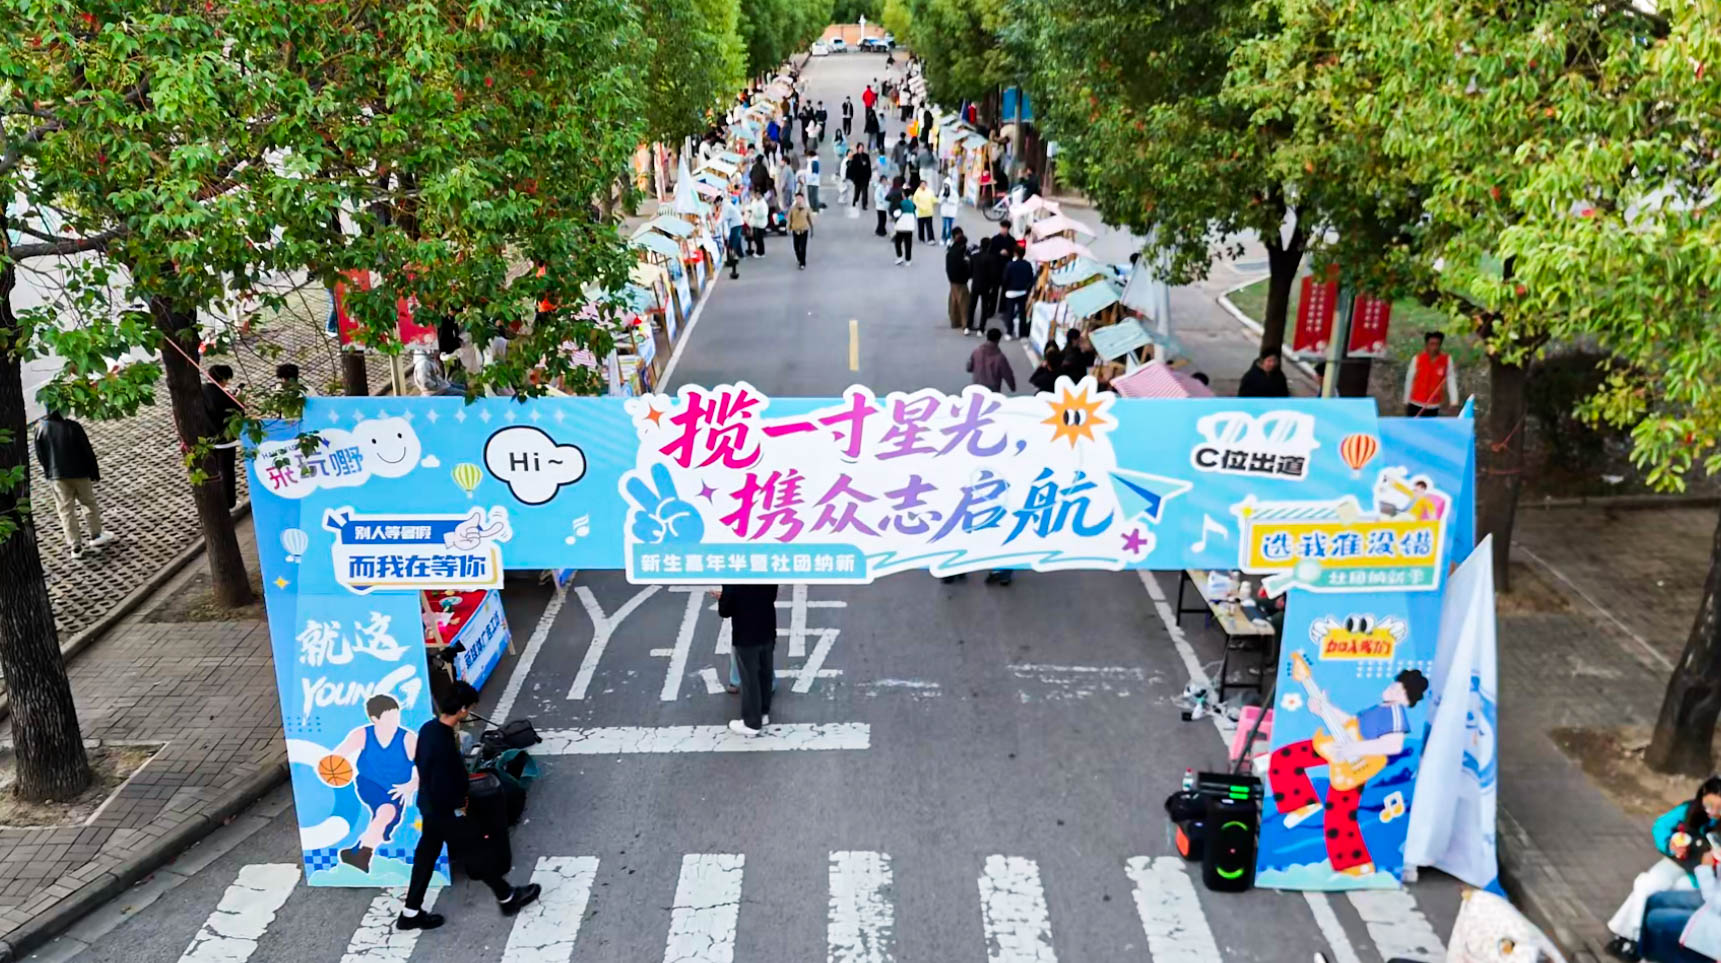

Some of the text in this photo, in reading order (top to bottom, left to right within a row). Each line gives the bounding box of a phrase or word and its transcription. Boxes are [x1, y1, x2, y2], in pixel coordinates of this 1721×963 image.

[659, 389, 1028, 469] 揽一寸星光，
[1195, 447, 1306, 476] C位出道
[719, 466, 1115, 544] 携众志启航
[354, 525, 432, 541] 别人等暑假
[1263, 531, 1432, 559] 选我准没错
[349, 554, 487, 578] 而我在等你
[640, 553, 856, 574] 新生嘉年华暨社团纳新
[296, 611, 411, 667] 就这
[301, 665, 422, 725] YOUNG
